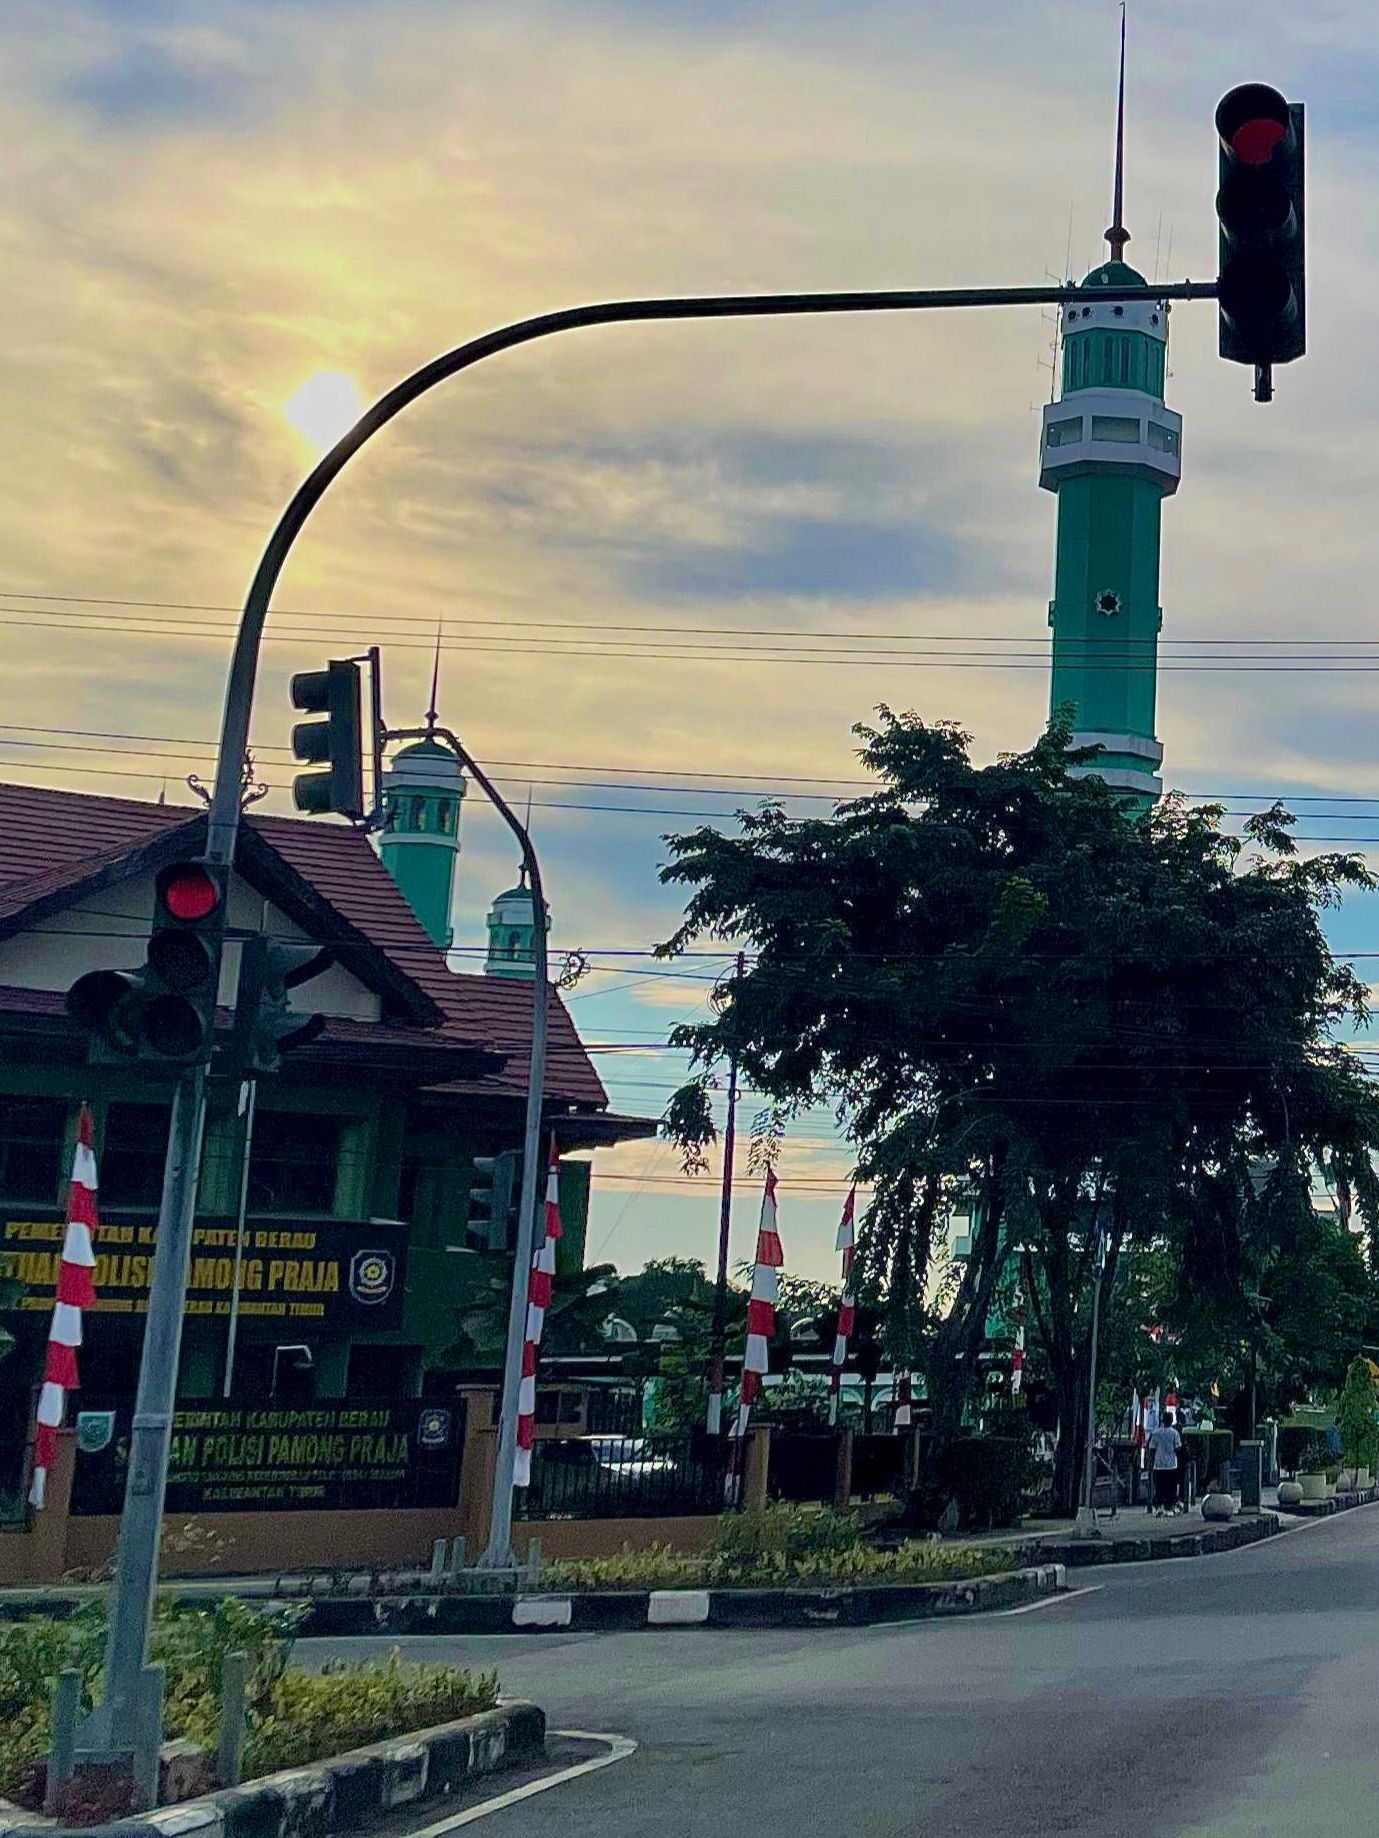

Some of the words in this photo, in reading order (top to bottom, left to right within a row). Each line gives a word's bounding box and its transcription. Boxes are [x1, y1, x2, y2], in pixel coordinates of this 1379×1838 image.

[255, 1231, 317, 1248] BERAU
[268, 1261, 339, 1292] PRAJA
[172, 1412, 241, 1428] ERINTAH
[246, 1410, 336, 1428] KABUPATEN
[338, 1409, 390, 1428] BERAU
[201, 1435, 265, 1466] POLISI
[268, 1434, 346, 1465] PAMONG
[350, 1433, 410, 1464] PRAJA
